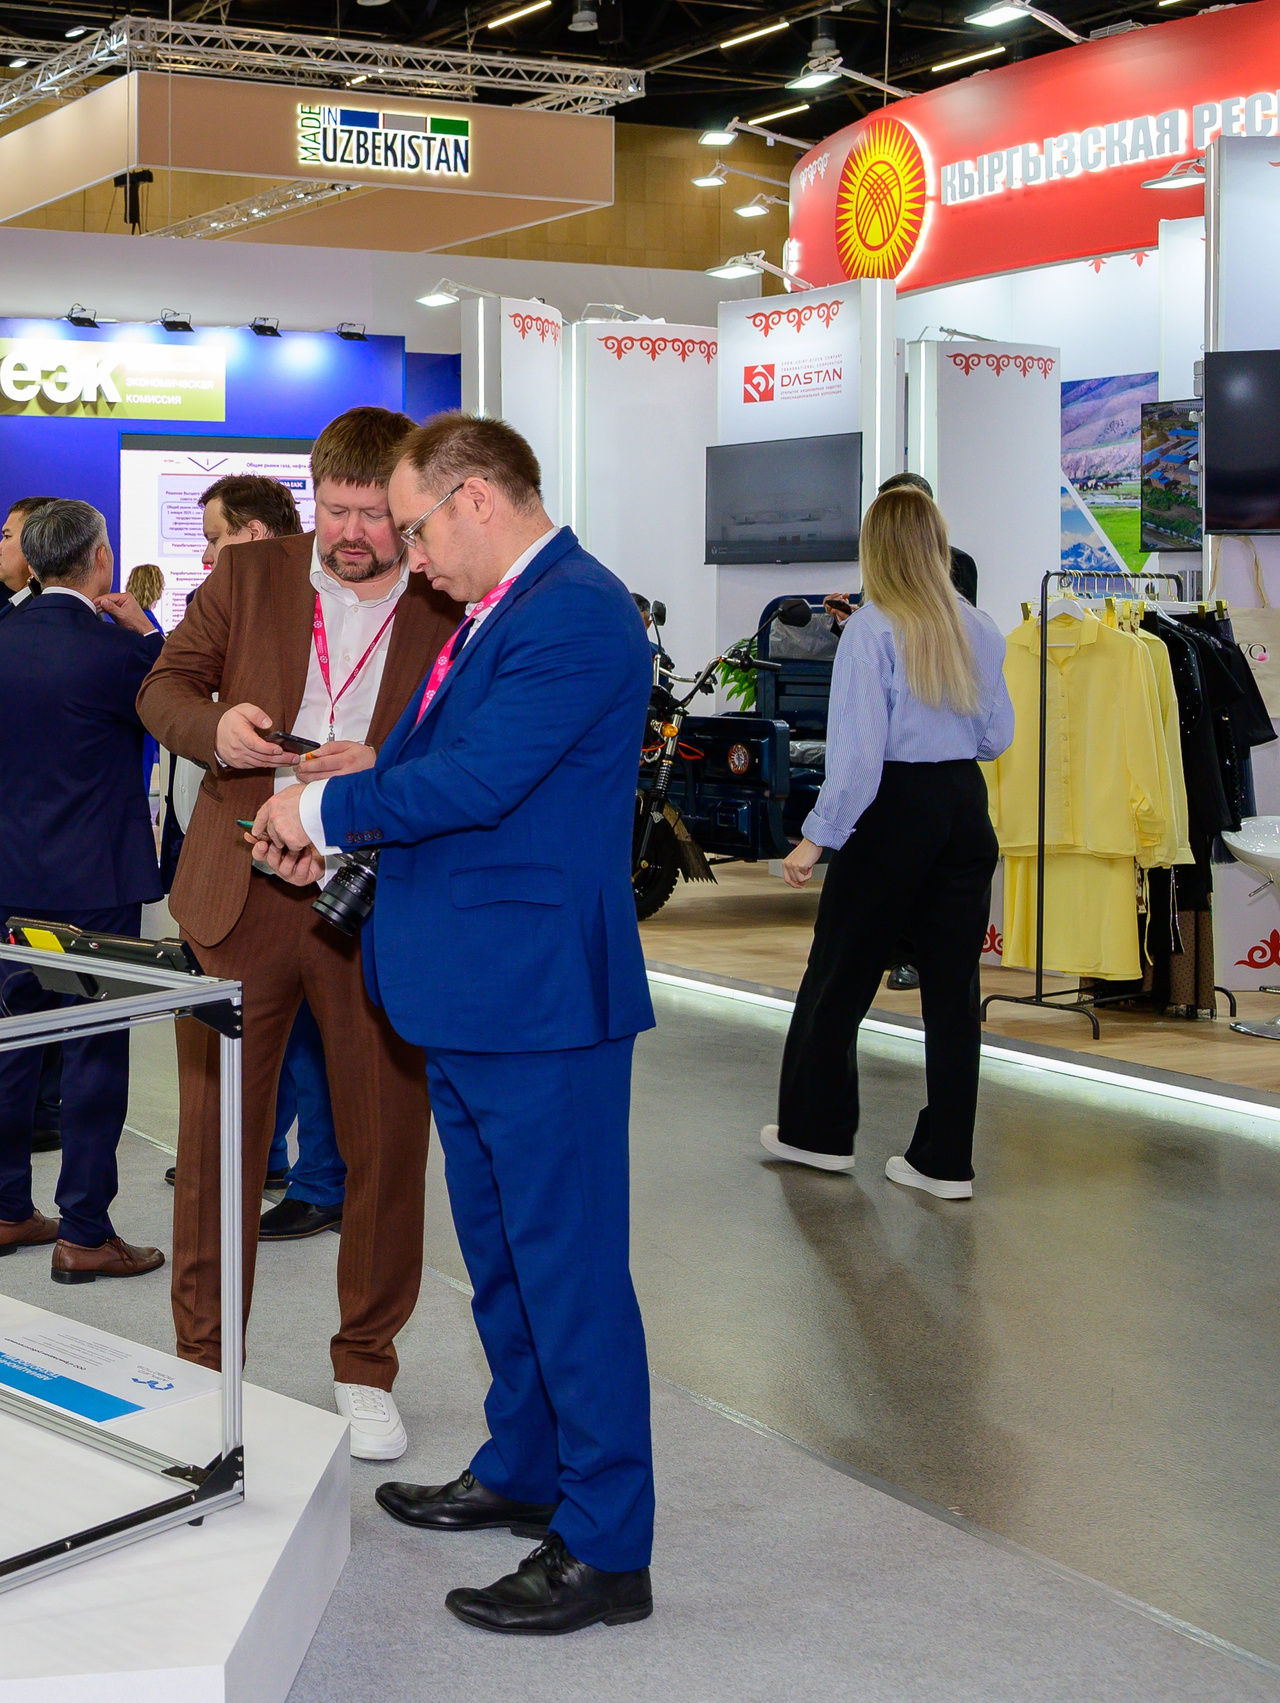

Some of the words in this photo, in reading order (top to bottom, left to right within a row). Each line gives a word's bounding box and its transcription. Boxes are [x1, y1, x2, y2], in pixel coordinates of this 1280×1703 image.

[322, 106, 338, 126] IN
[300, 104, 321, 162] MADE
[941, 109, 1180, 205] КЫРГЫЗСКАЯ
[1193, 89, 1280, 149] РЕС
[322, 127, 470, 174] UZBEKISTAN
[781, 367, 842, 387] DASTAN
[125, 393, 182, 405] КОМИССИЯ
